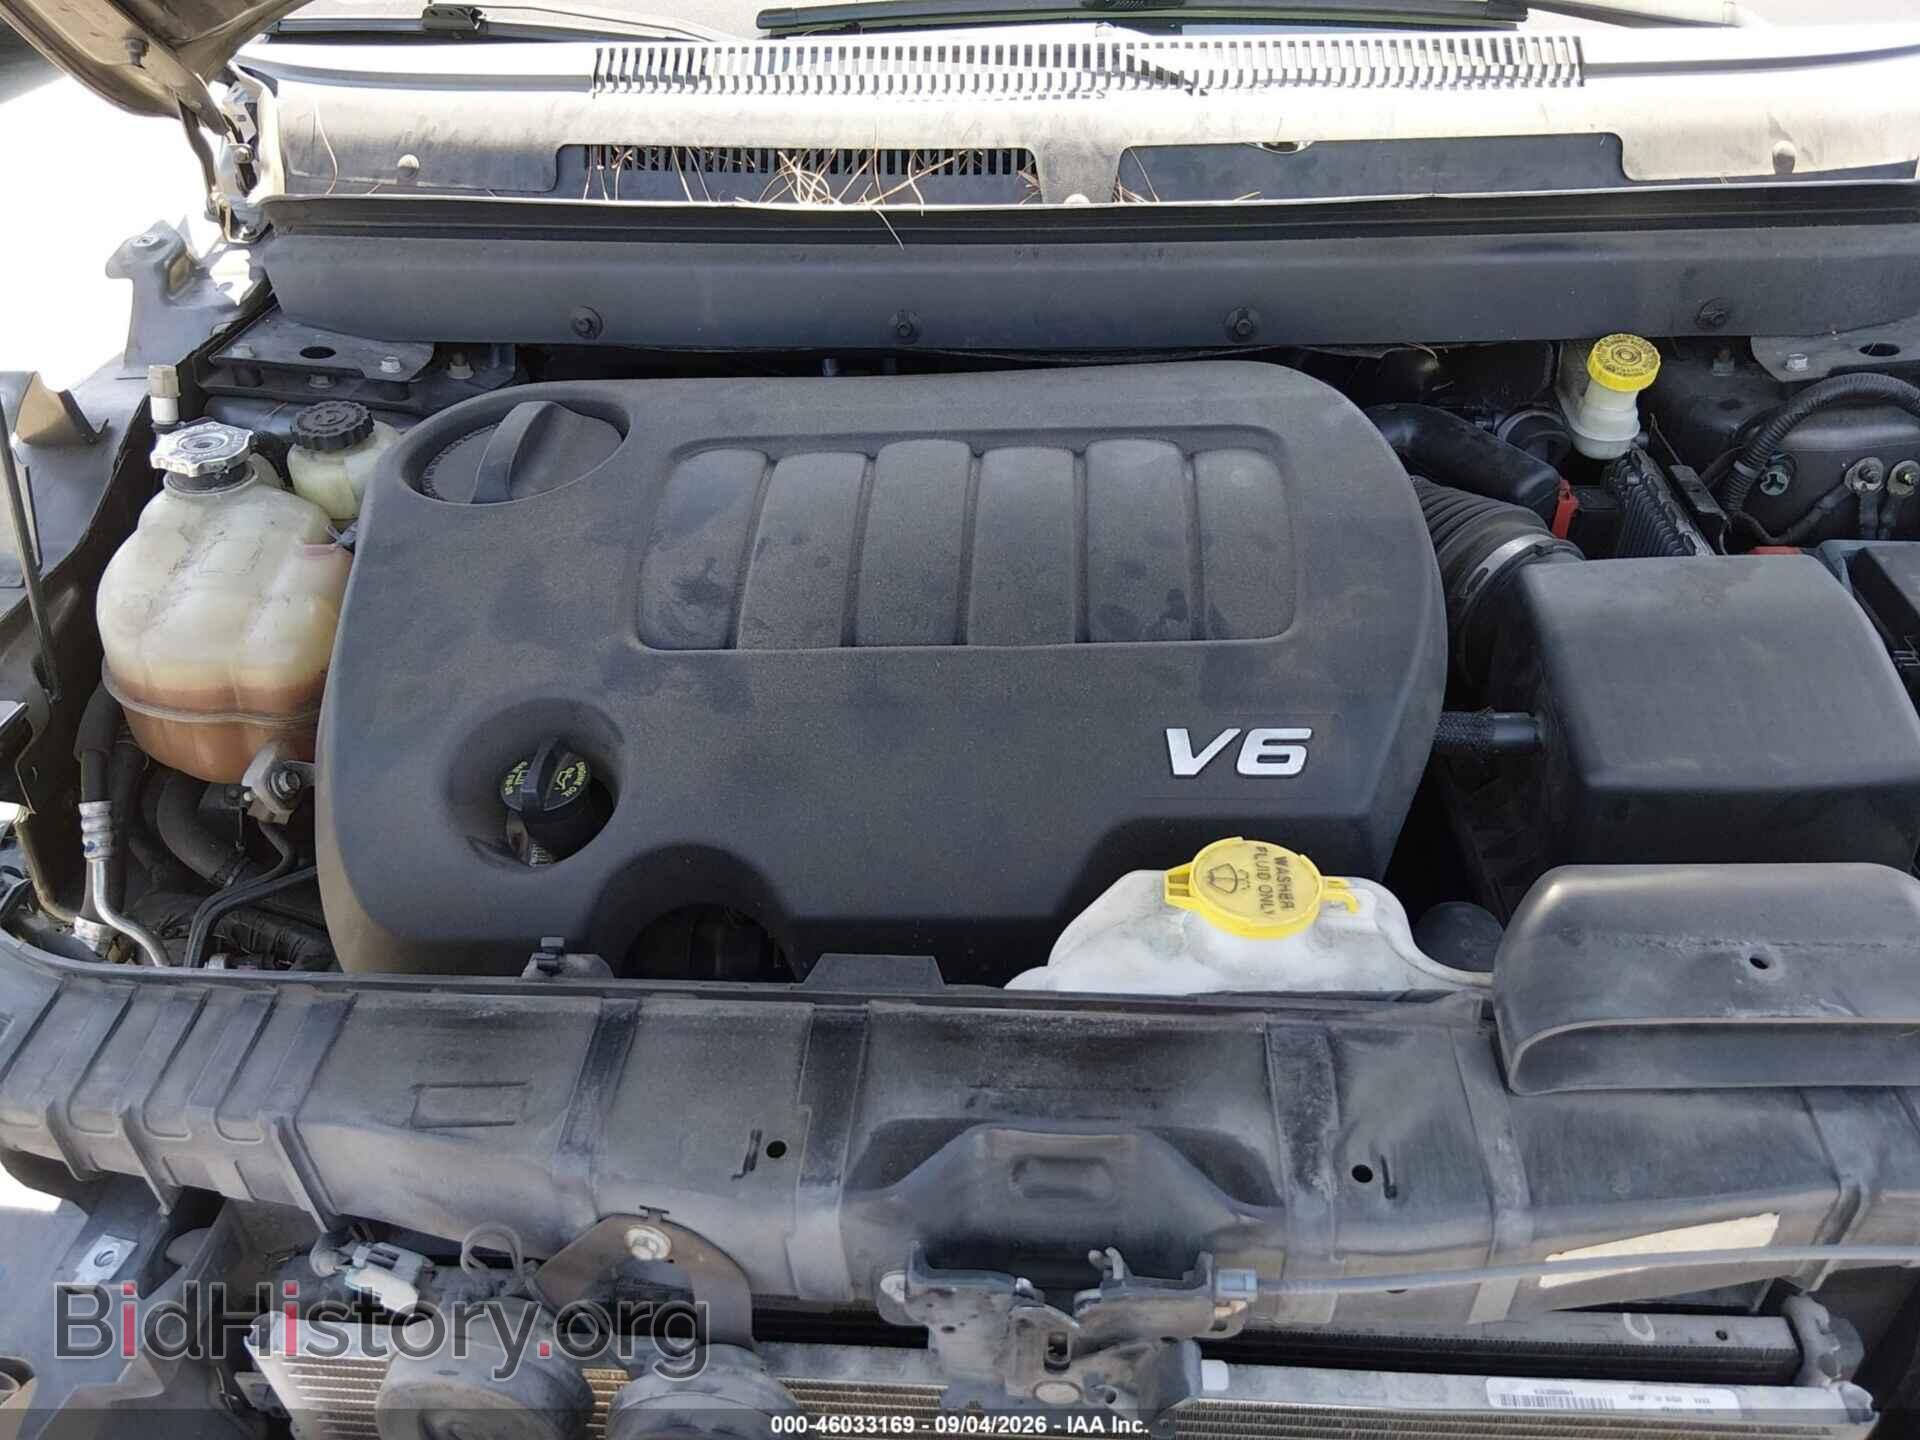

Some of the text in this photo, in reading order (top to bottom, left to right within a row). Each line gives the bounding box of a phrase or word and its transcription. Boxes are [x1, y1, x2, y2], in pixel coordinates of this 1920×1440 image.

[1165, 727, 1312, 777] V6
[561, 761, 586, 797] ENGINE OIL
[1254, 846, 1276, 915] FLUID ONLY
[1274, 855, 1295, 911] WASHER
